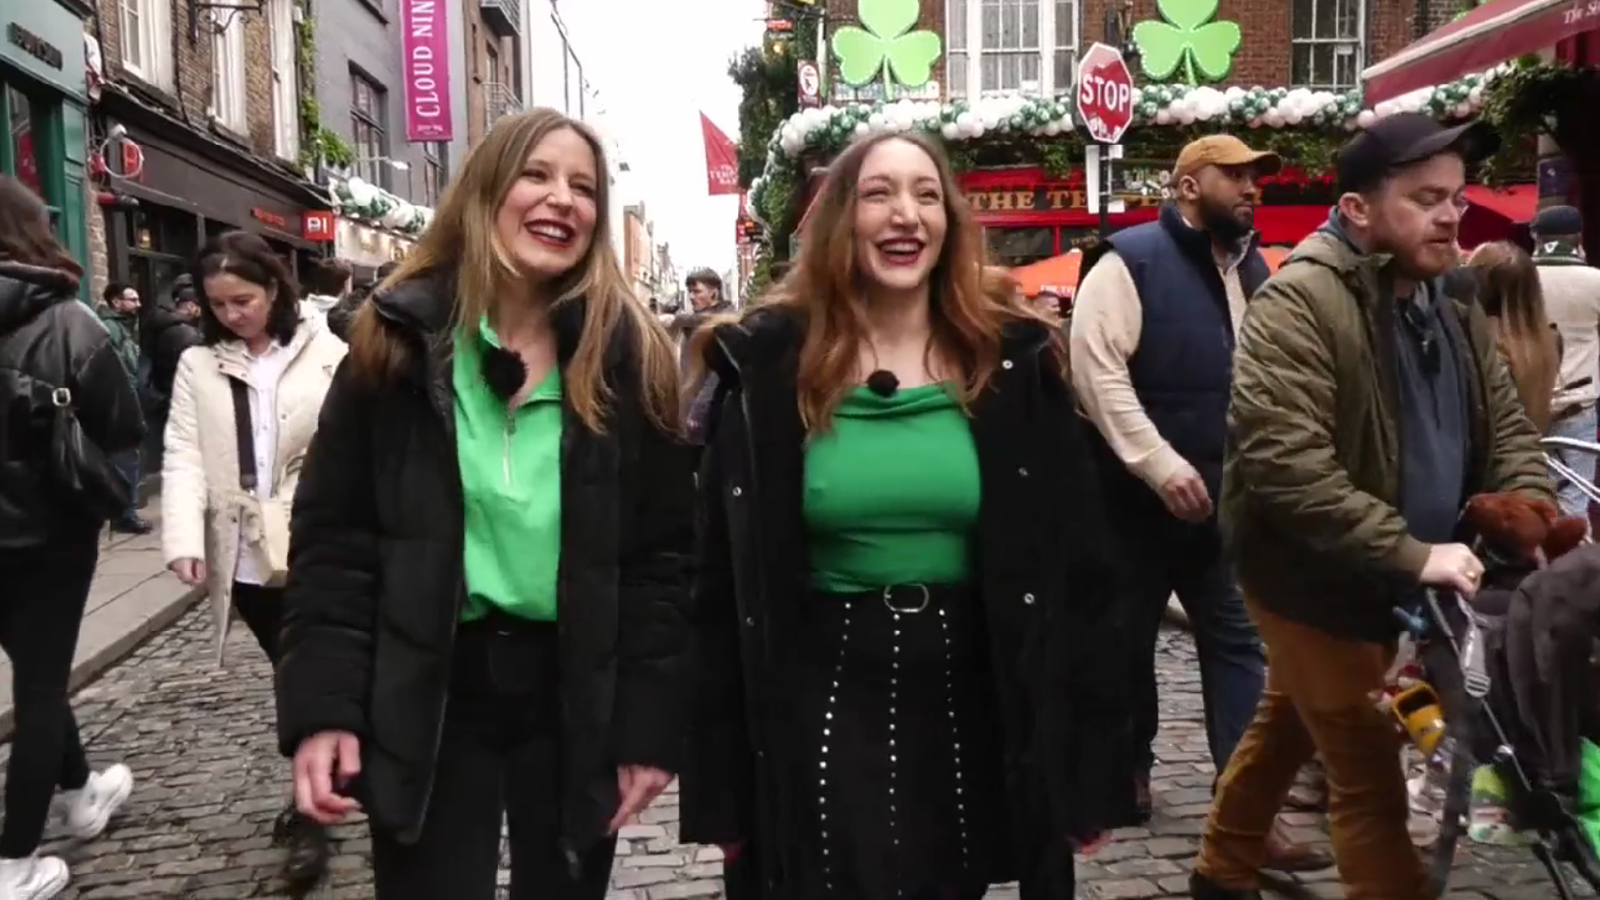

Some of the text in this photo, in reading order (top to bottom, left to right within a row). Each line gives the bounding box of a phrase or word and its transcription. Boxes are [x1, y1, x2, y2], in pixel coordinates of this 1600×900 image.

[411, 0, 435, 38] NIN
[1563, 0, 1584, 24] The
[412, 46, 440, 117] CLOUD
[1082, 73, 1129, 111] STOP
[969, 190, 1036, 210] THE
